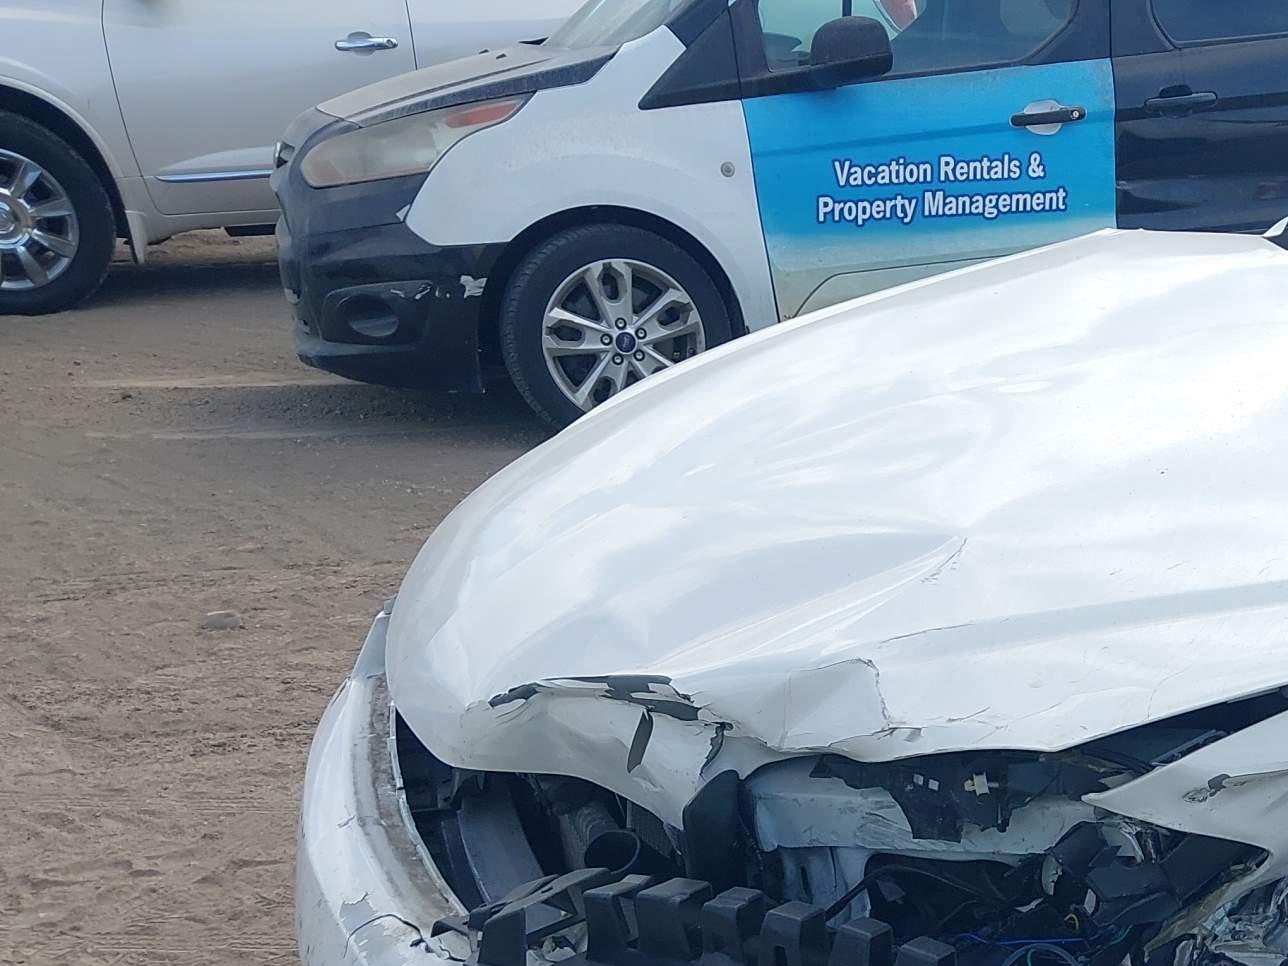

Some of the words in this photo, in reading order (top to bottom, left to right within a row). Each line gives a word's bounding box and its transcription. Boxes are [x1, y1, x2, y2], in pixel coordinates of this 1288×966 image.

[834, 158, 932, 186] Vacation
[940, 154, 1020, 181] Rentals
[1028, 153, 1045, 178] &
[818, 195, 917, 225] Property
[923, 187, 1067, 218] Management
